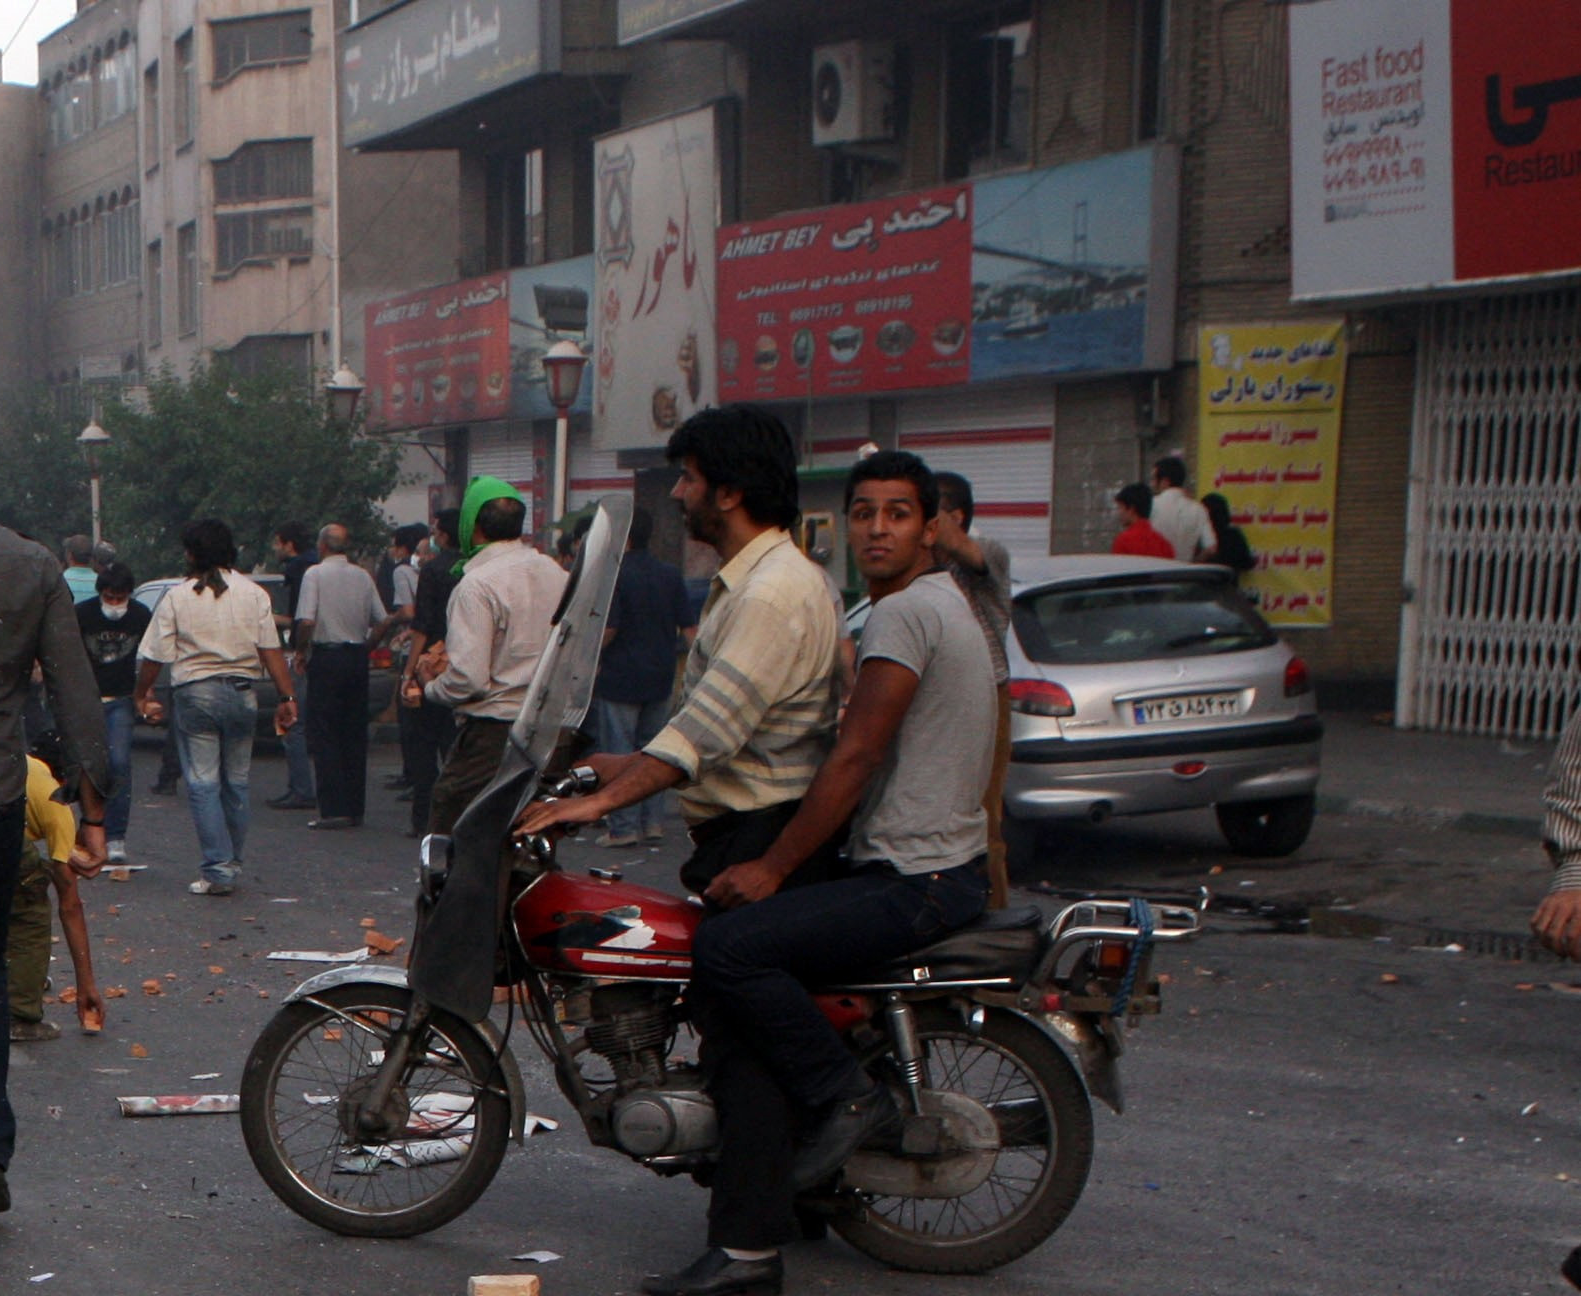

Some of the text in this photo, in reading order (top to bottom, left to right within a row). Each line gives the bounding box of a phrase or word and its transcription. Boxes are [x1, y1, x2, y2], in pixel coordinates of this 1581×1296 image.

[1322, 37, 1424, 89] Fast food
[1321, 77, 1423, 118] Restaurant
[1485, 148, 1581, 188] Restau
[719, 224, 824, 261] AHMET BEY
[1258, 375, 1335, 402] رستوران
